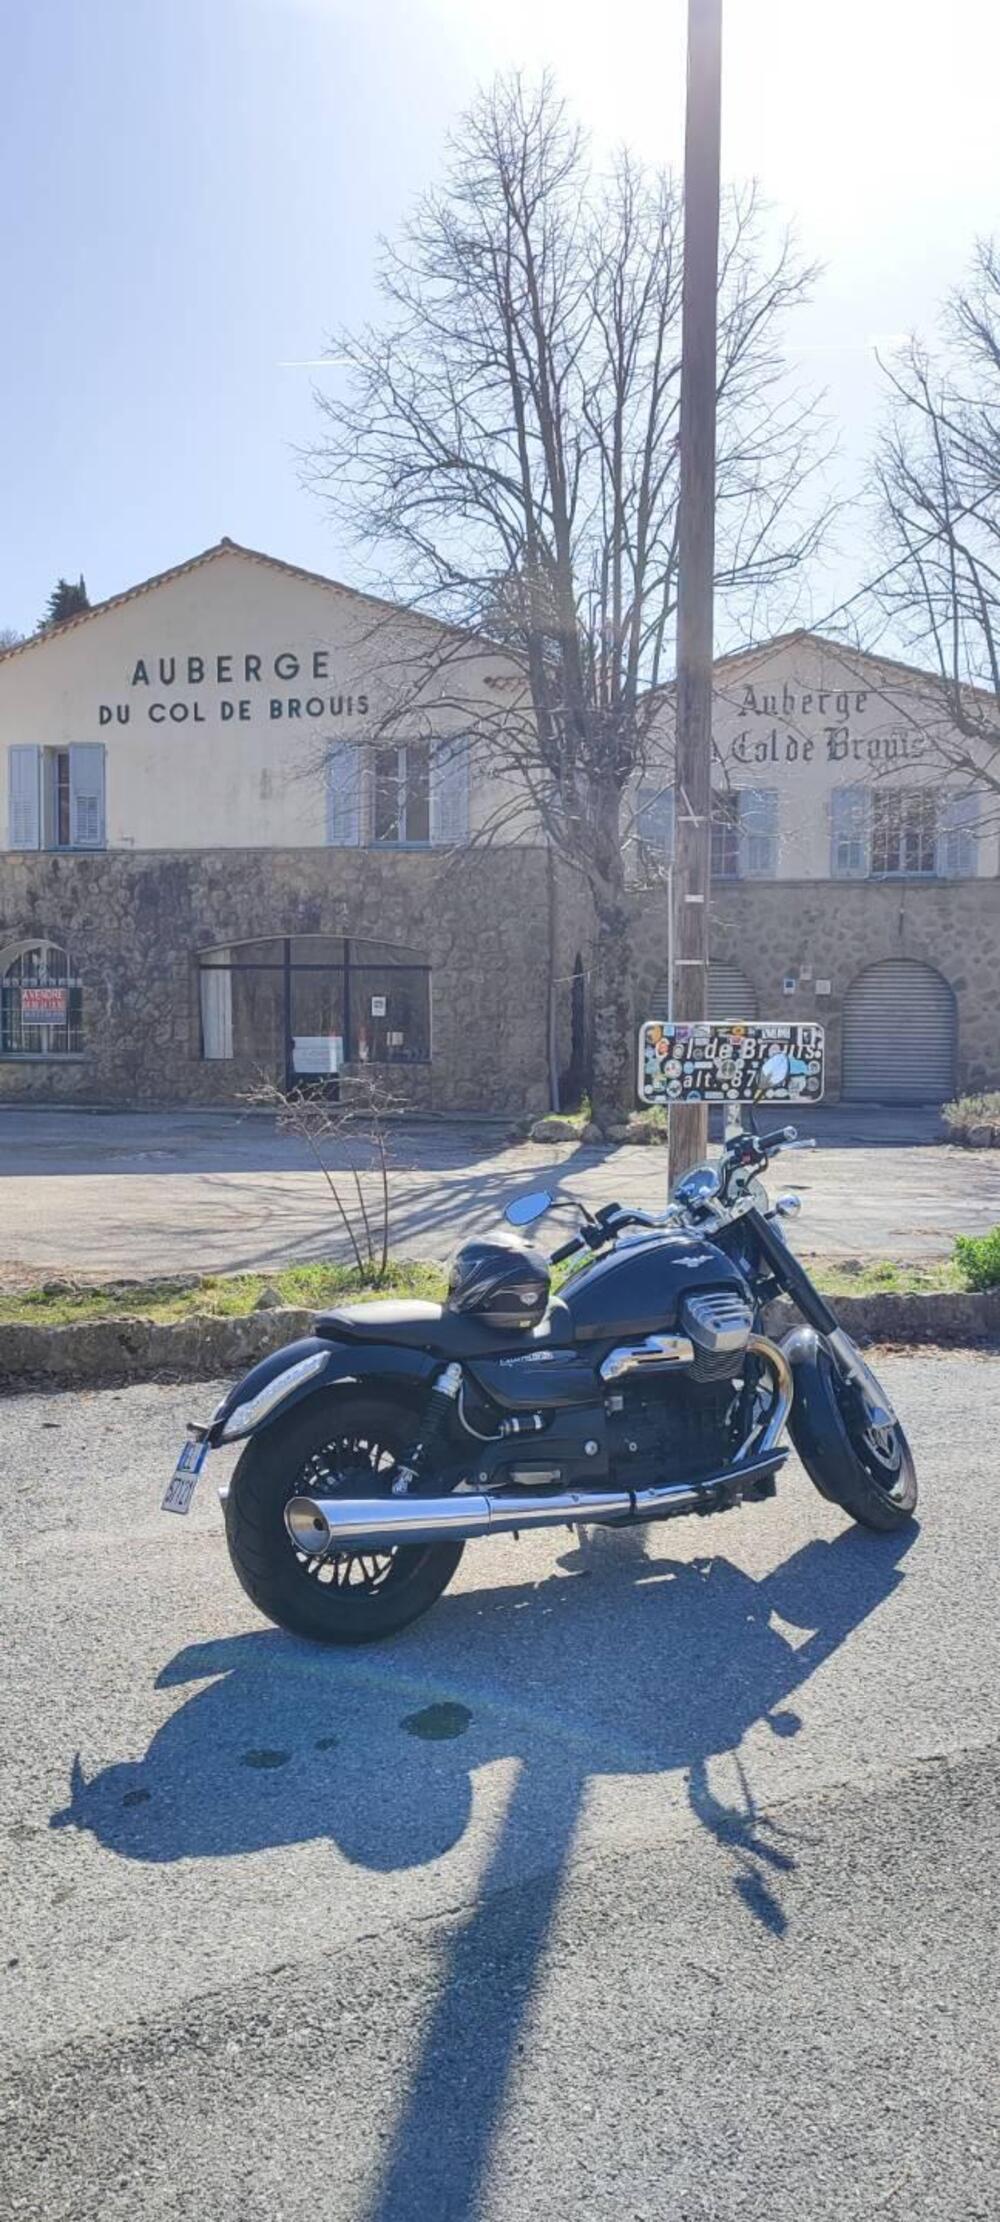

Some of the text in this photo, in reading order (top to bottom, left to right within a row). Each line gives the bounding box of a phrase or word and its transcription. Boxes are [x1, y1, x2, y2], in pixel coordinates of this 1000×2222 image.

[131, 651, 330, 687] AUBERGE
[99, 695, 370, 725] DU COL DE BROUIS
[737, 682, 868, 723] Auberge
[731, 728, 778, 763] Col
[786, 735, 814, 762] de
[705, 1038, 733, 1059] de
